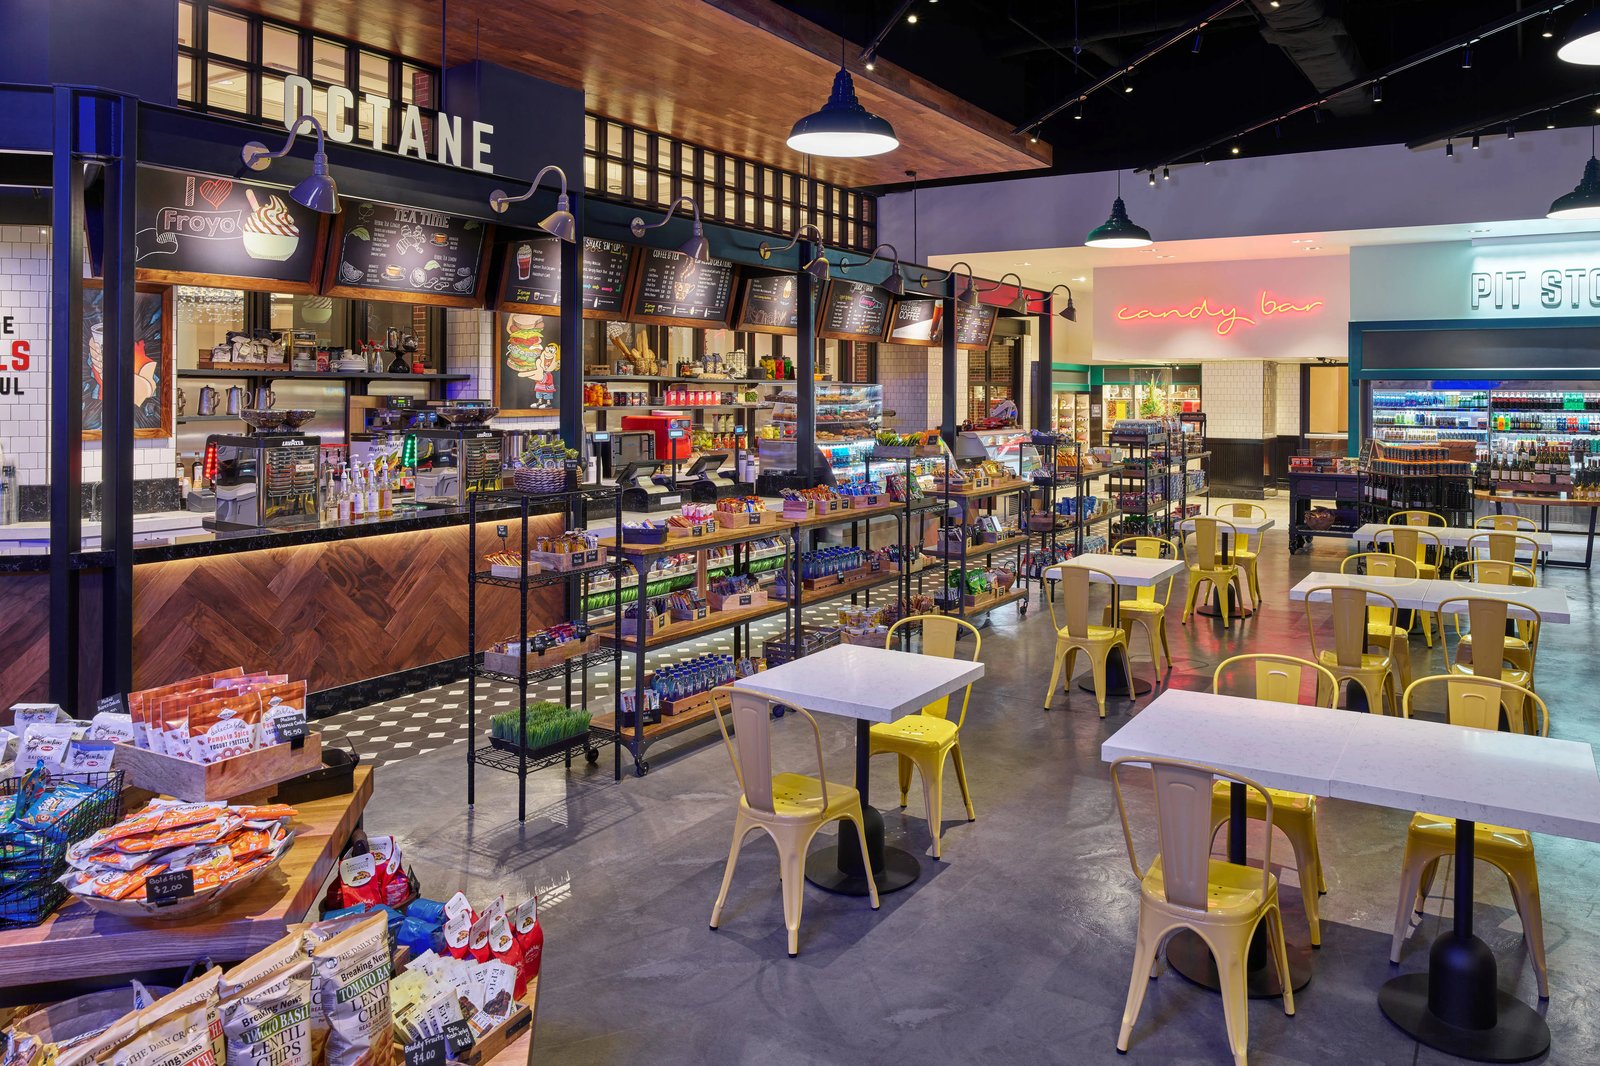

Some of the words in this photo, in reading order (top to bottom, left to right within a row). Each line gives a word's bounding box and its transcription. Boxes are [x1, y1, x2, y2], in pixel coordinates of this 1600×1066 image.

[284, 75, 494, 174] OCTANE
[185, 177, 195, 206] I
[163, 210, 237, 238] Froyo
[394, 208, 416, 224] TEA
[420, 212, 450, 228] TIME
[585, 238, 602, 251] SHAKE
[652, 249, 667, 260] COFFEE
[672, 252, 680, 261] TEA
[1471, 271, 1526, 310] PIT
[899, 310, 920, 320] COFFEE
[900, 304, 911, 312] COLD
[911, 305, 922, 313] BREW
[1117, 298, 1256, 335] candy
[1261, 291, 1322, 315] bar
[207, 733, 232, 744] Pumpkin
[234, 730, 249, 739] Spice
[283, 728, 302, 737] $5.50
[210, 741, 228, 750] YOGURT
[154, 884, 183, 895] $2.00
[353, 939, 371, 954] DAILY
[262, 961, 284, 978] DAILY
[340, 960, 373, 982] Breaking
[339, 974, 376, 1001] TOMATO
[241, 1004, 278, 1028] Breaking
[280, 993, 302, 1009] News
[358, 995, 389, 1024] CHIP
[243, 1016, 279, 1043] TOMATO
[128, 1048, 148, 1065] THE
[149, 1036, 171, 1052] DAILY
[179, 1043, 203, 1059] News
[250, 1025, 306, 1059] LENTIL
[404, 1041, 424, 1053] Buddy
[424, 1034, 445, 1047] Fruits
[256, 1041, 302, 1066] CHIPS
[412, 1049, 436, 1065] $4.00
